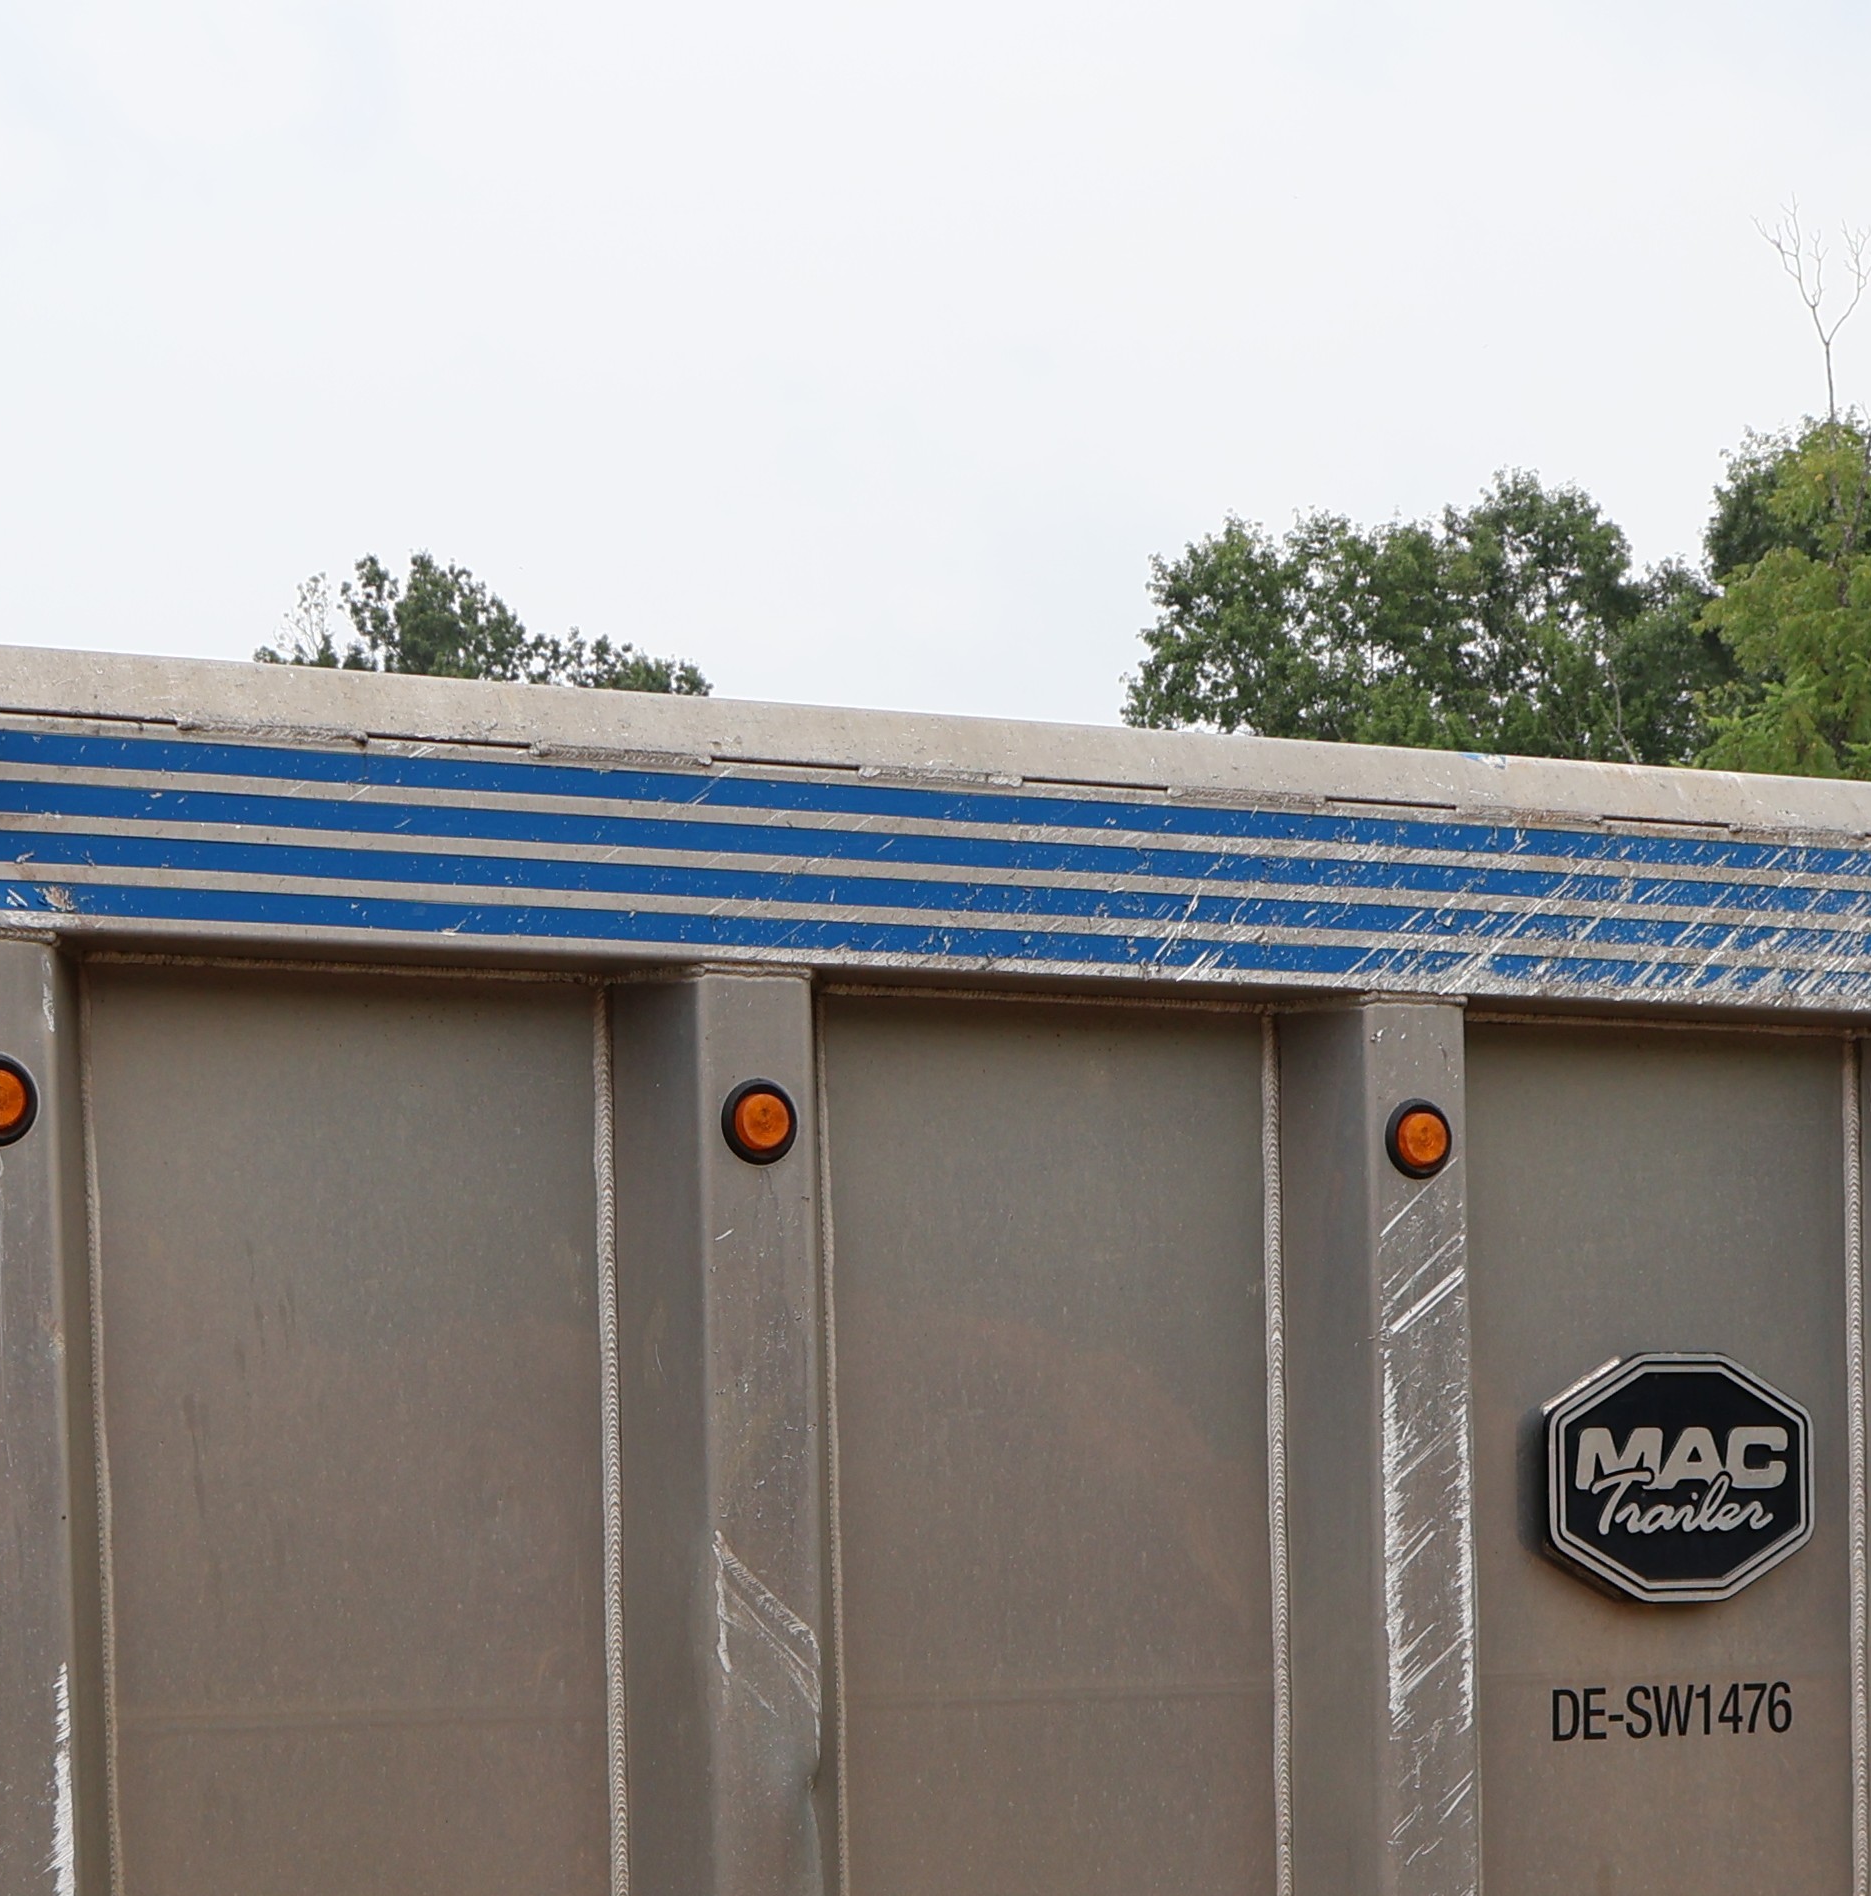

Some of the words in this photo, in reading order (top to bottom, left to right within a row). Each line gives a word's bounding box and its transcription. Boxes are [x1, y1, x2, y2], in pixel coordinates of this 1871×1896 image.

[1575, 1426, 1789, 1489] MAC
[1591, 1471, 1774, 1536] Trailer
[1551, 1681, 1792, 1741] DE-SW1476
